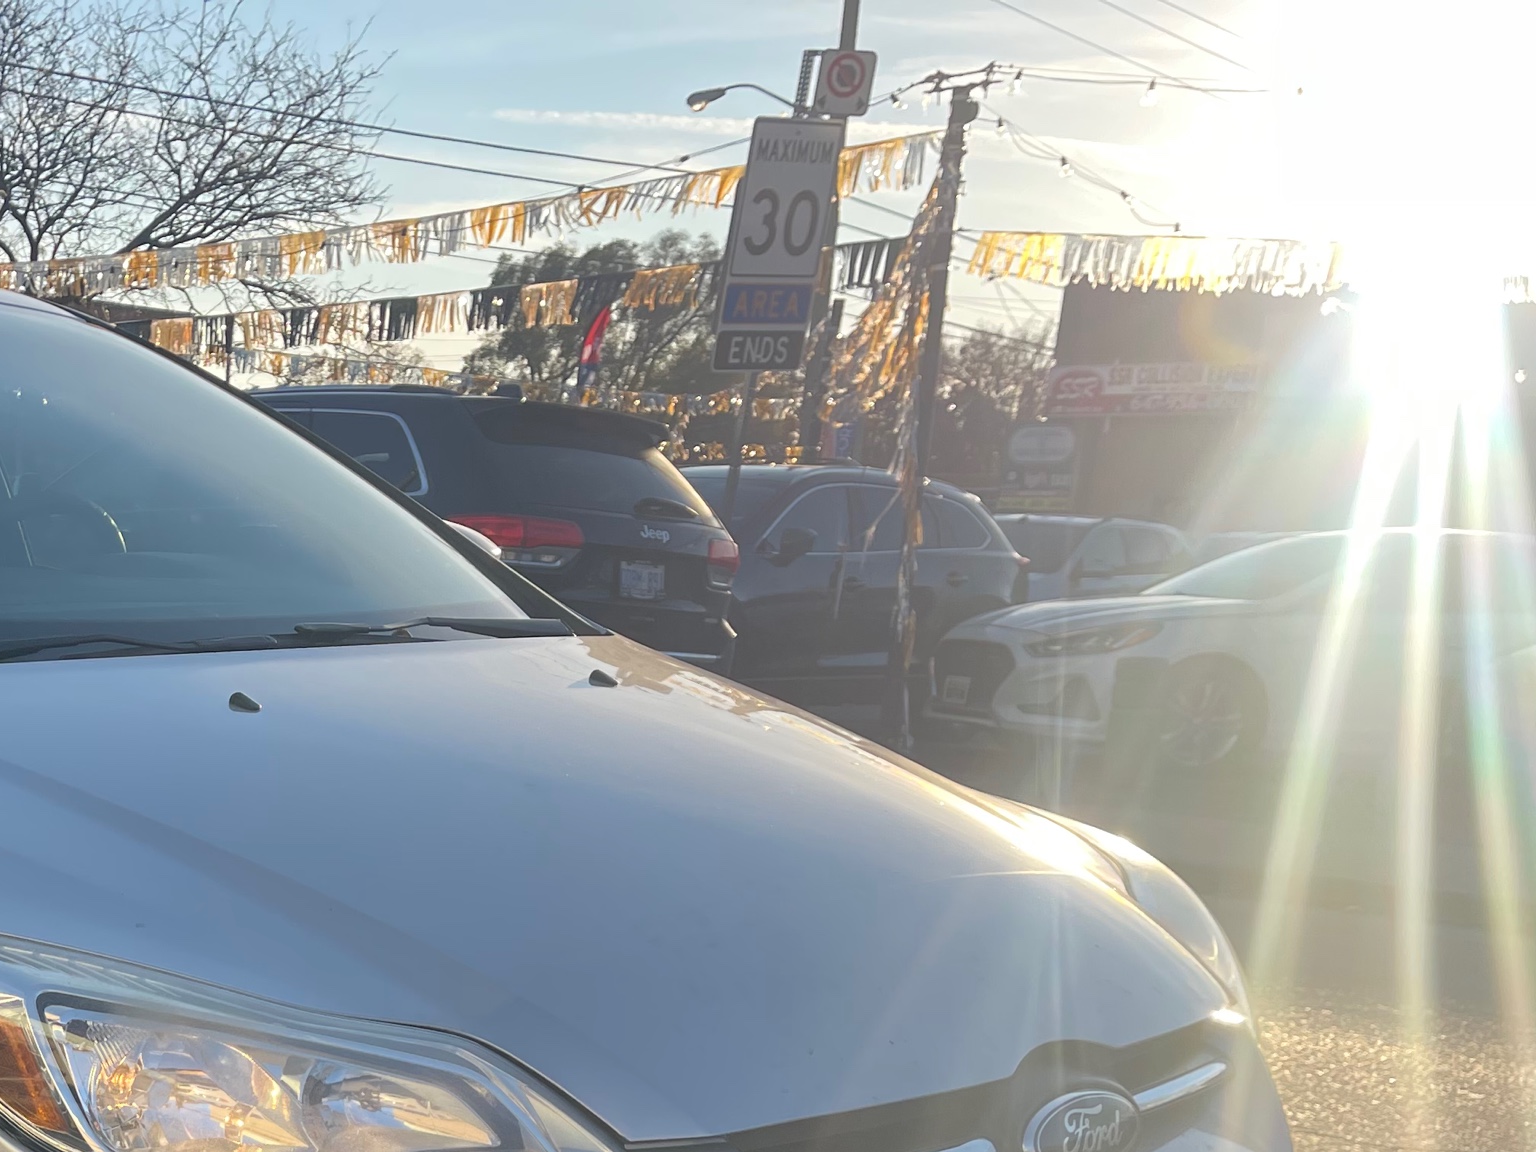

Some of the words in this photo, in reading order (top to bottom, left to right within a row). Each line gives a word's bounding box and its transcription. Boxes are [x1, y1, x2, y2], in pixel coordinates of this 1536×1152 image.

[757, 138, 835, 164] MAXIMUM
[744, 187, 821, 256] 30
[732, 289, 799, 319] AREA
[728, 336, 790, 364] ENDS
[640, 524, 670, 543] Jeep
